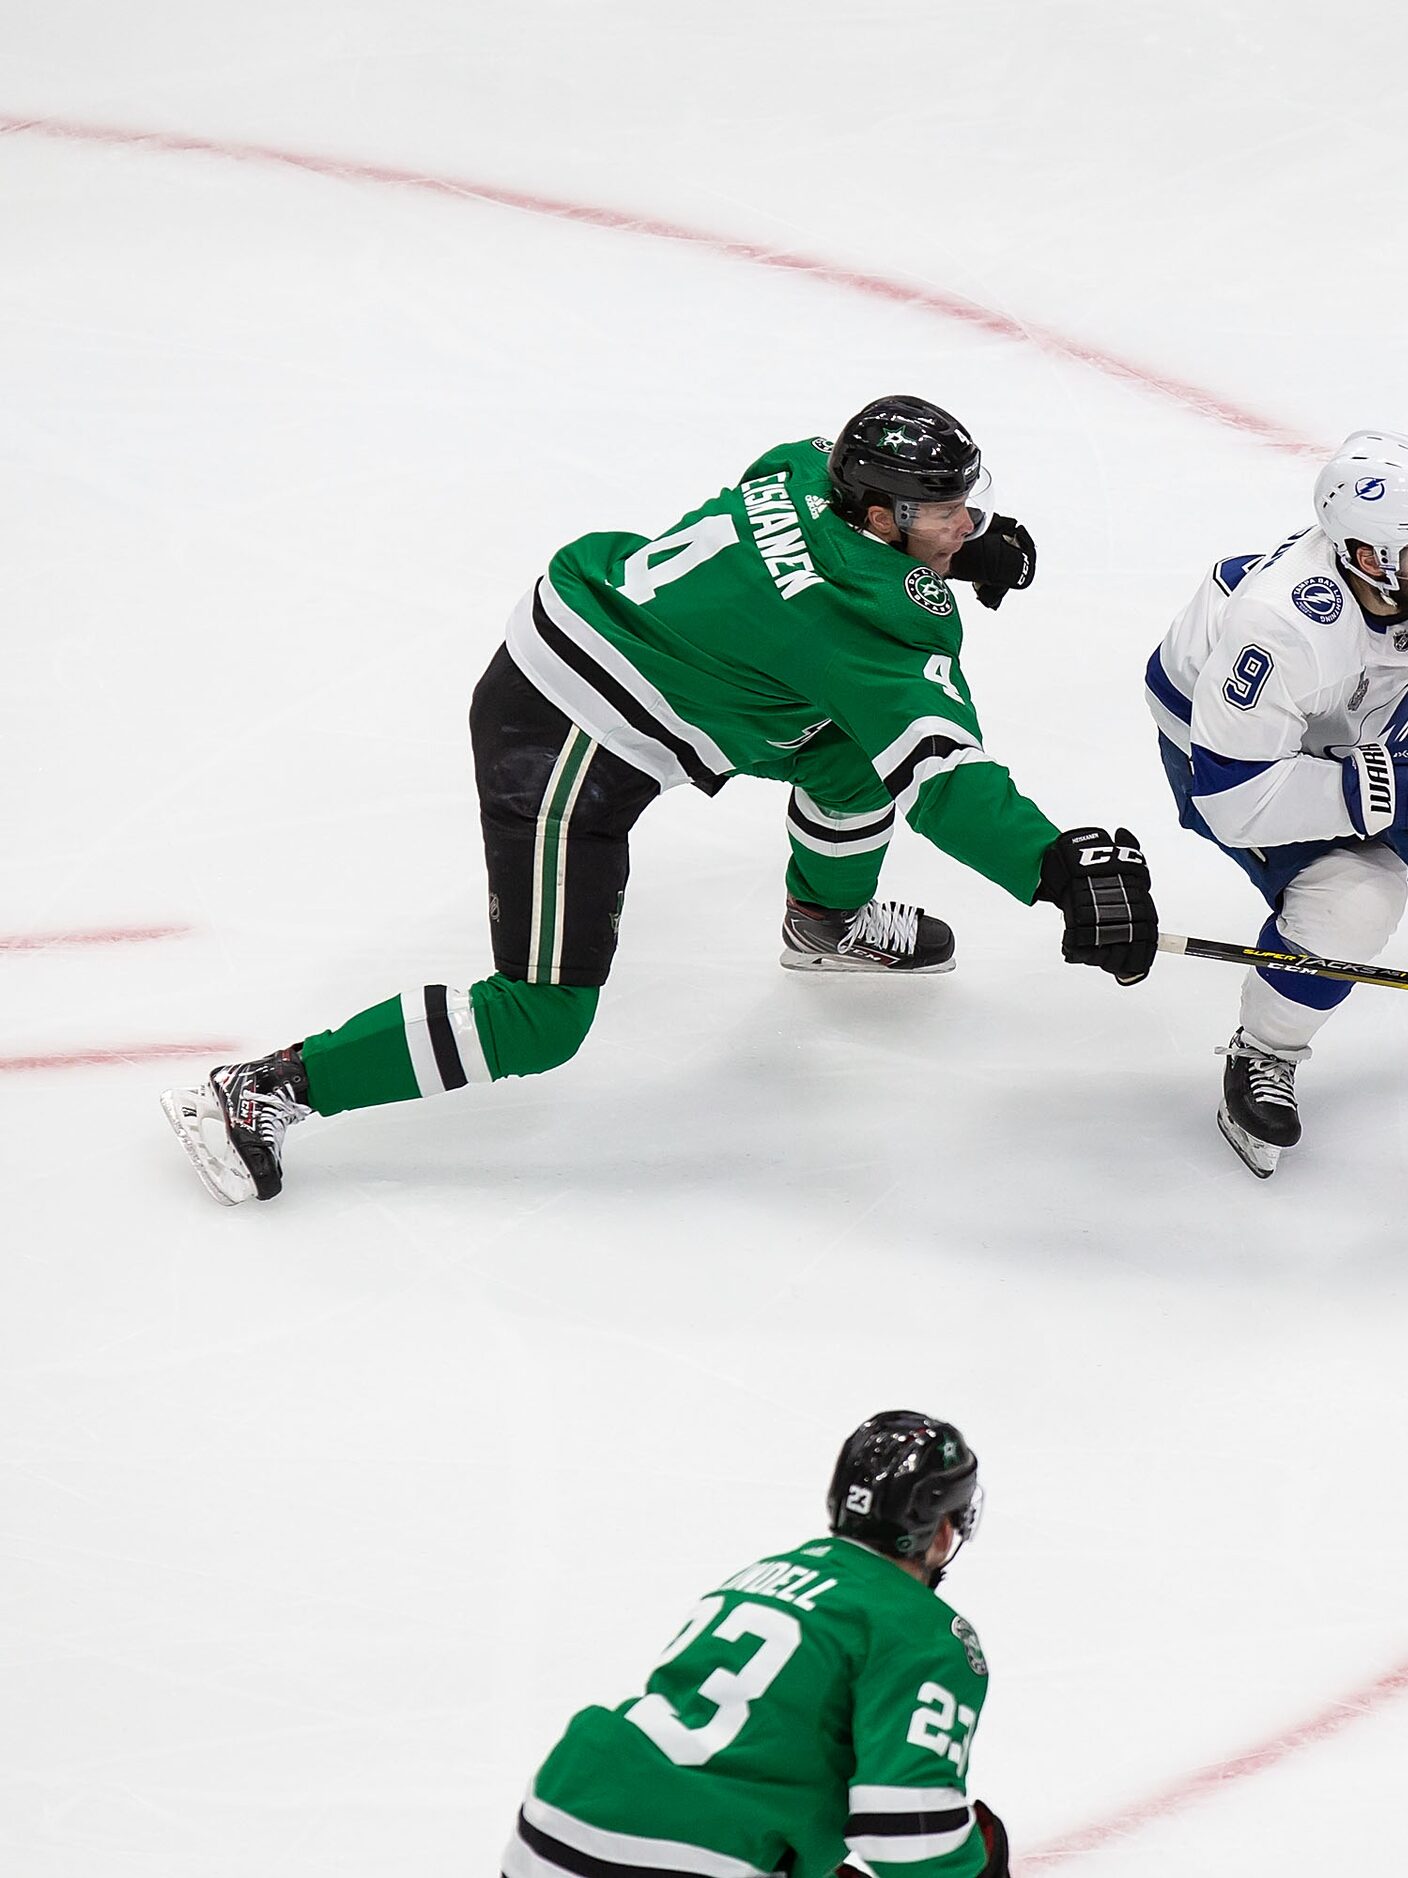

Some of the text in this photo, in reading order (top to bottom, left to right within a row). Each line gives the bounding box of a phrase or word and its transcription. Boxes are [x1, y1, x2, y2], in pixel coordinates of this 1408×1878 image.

[741, 471, 825, 600] EISKANEN
[605, 514, 740, 605] 4
[1293, 578, 1316, 596] TAMPA
[1317, 577, 1335, 588] BAY
[1319, 589, 1342, 623] LIGHTNING
[1222, 643, 1274, 711] 9
[1079, 846, 1143, 867] CC
[1267, 962, 1319, 976] CCM
[846, 1485, 872, 1515] 23
